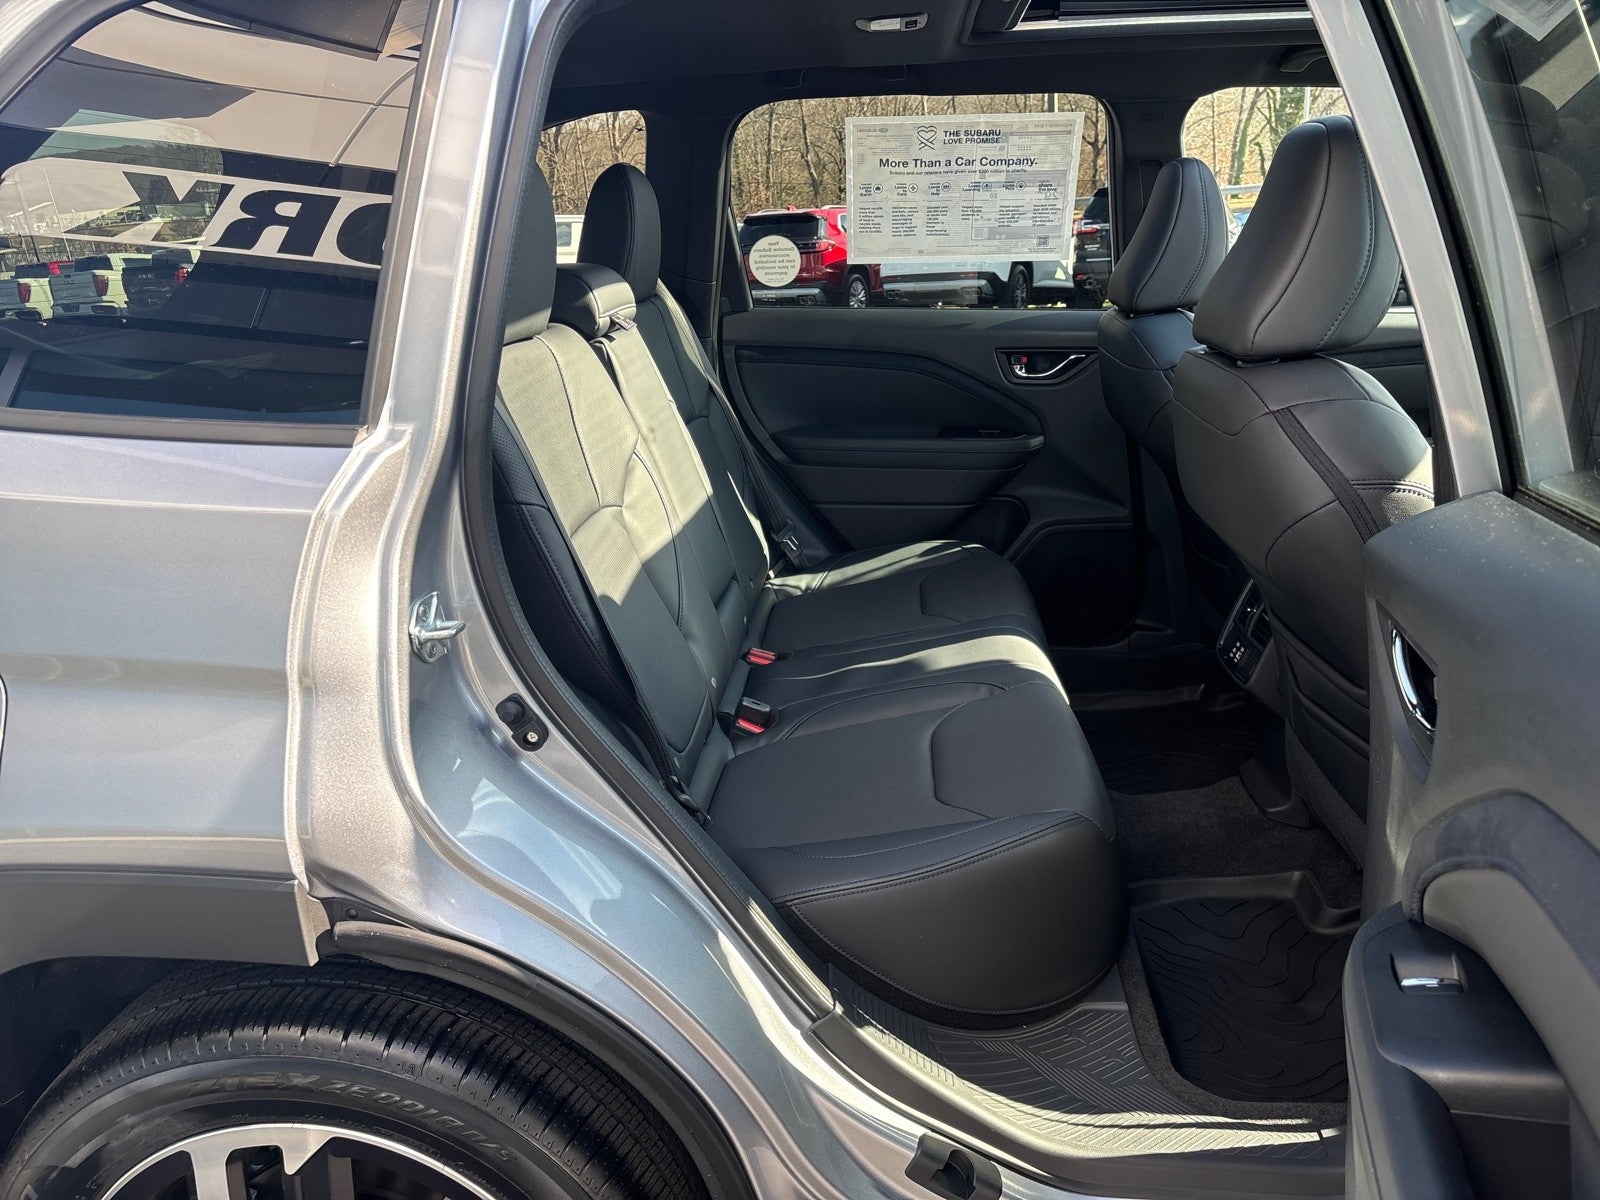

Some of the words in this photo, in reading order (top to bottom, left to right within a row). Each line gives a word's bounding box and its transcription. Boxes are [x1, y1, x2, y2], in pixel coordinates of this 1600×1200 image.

[943, 130, 961, 138] THE
[964, 129, 1001, 137] SUBARU
[879, 158, 909, 168] More
[913, 157, 941, 168] Than
[944, 159, 952, 167] a
[955, 156, 977, 167] Car
[979, 156, 1038, 168] Company.
